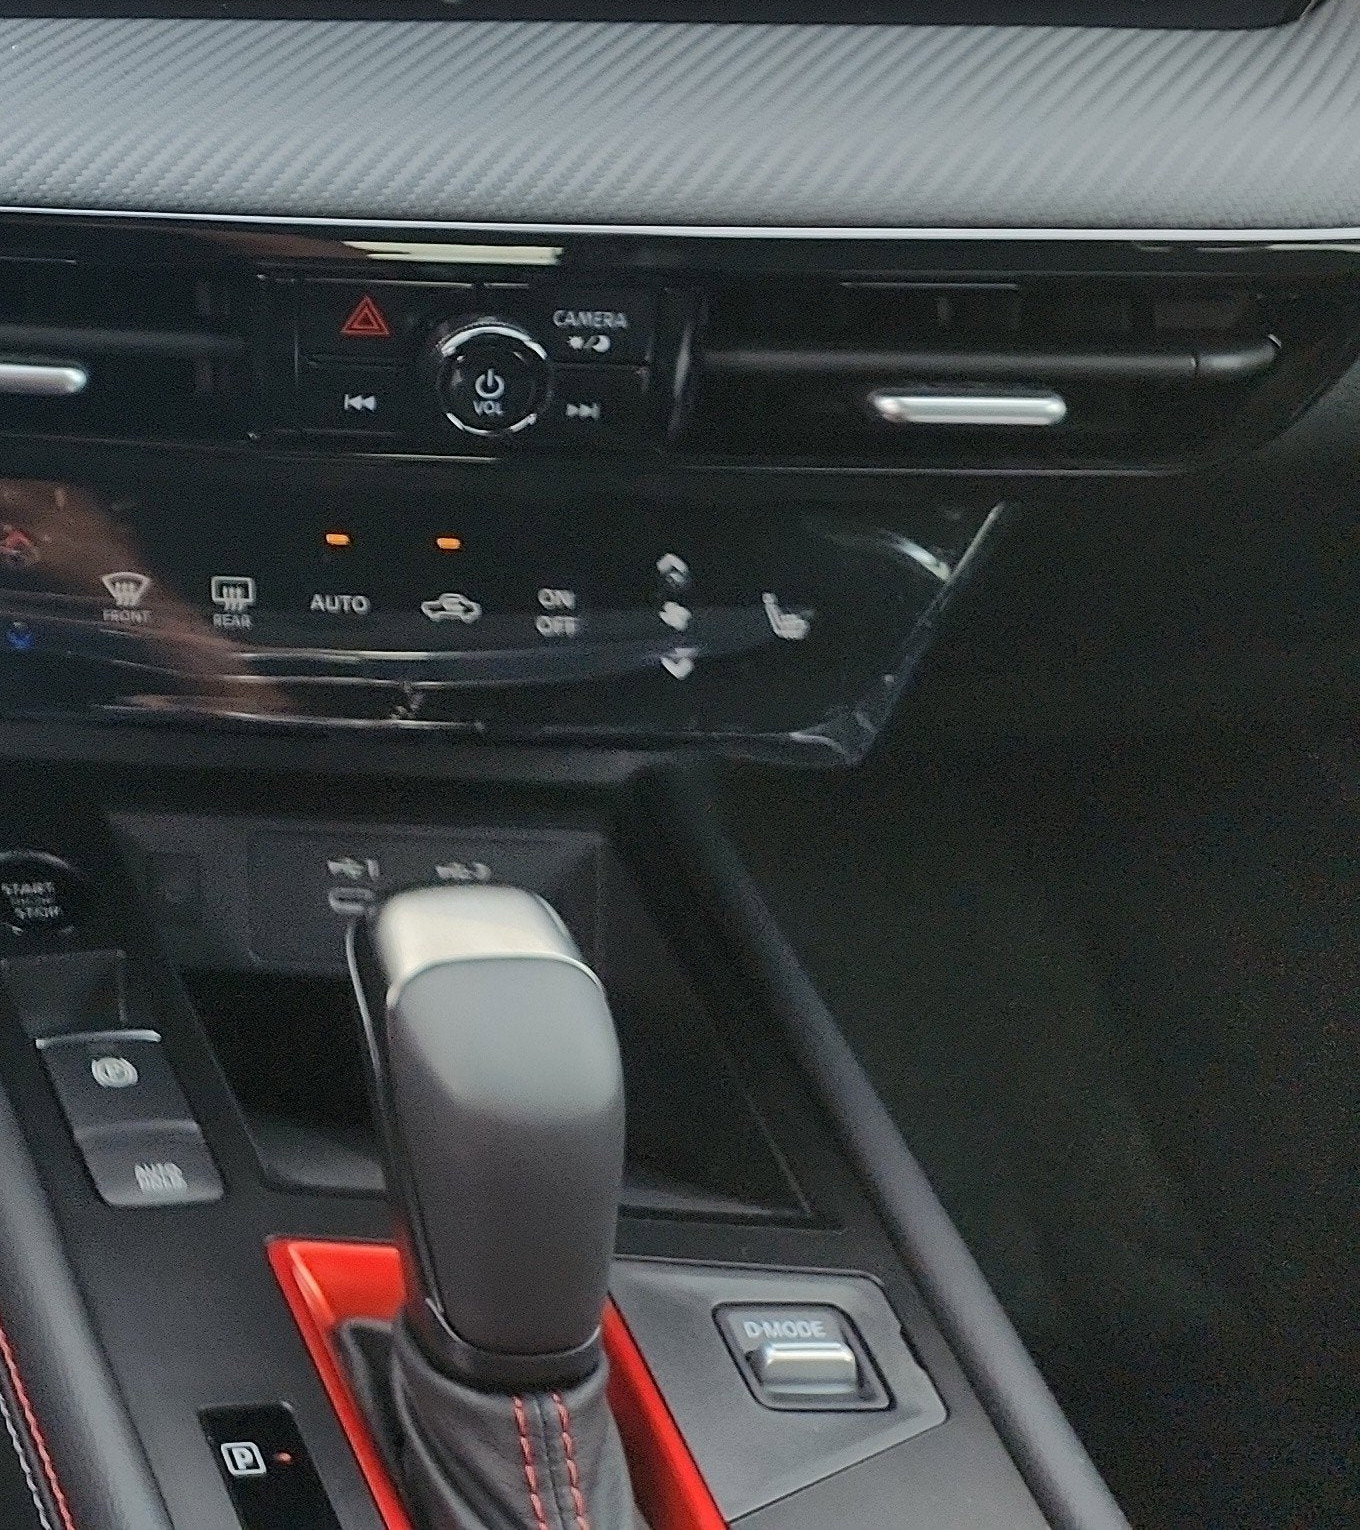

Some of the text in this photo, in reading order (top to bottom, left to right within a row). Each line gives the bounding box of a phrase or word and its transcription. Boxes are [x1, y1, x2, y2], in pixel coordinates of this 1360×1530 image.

[553, 310, 628, 329] CAMERA
[473, 400, 504, 417] VOL
[310, 593, 370, 614] AUTO
[537, 587, 576, 611] ON
[103, 609, 152, 623] FRONT
[213, 613, 254, 630] REAR
